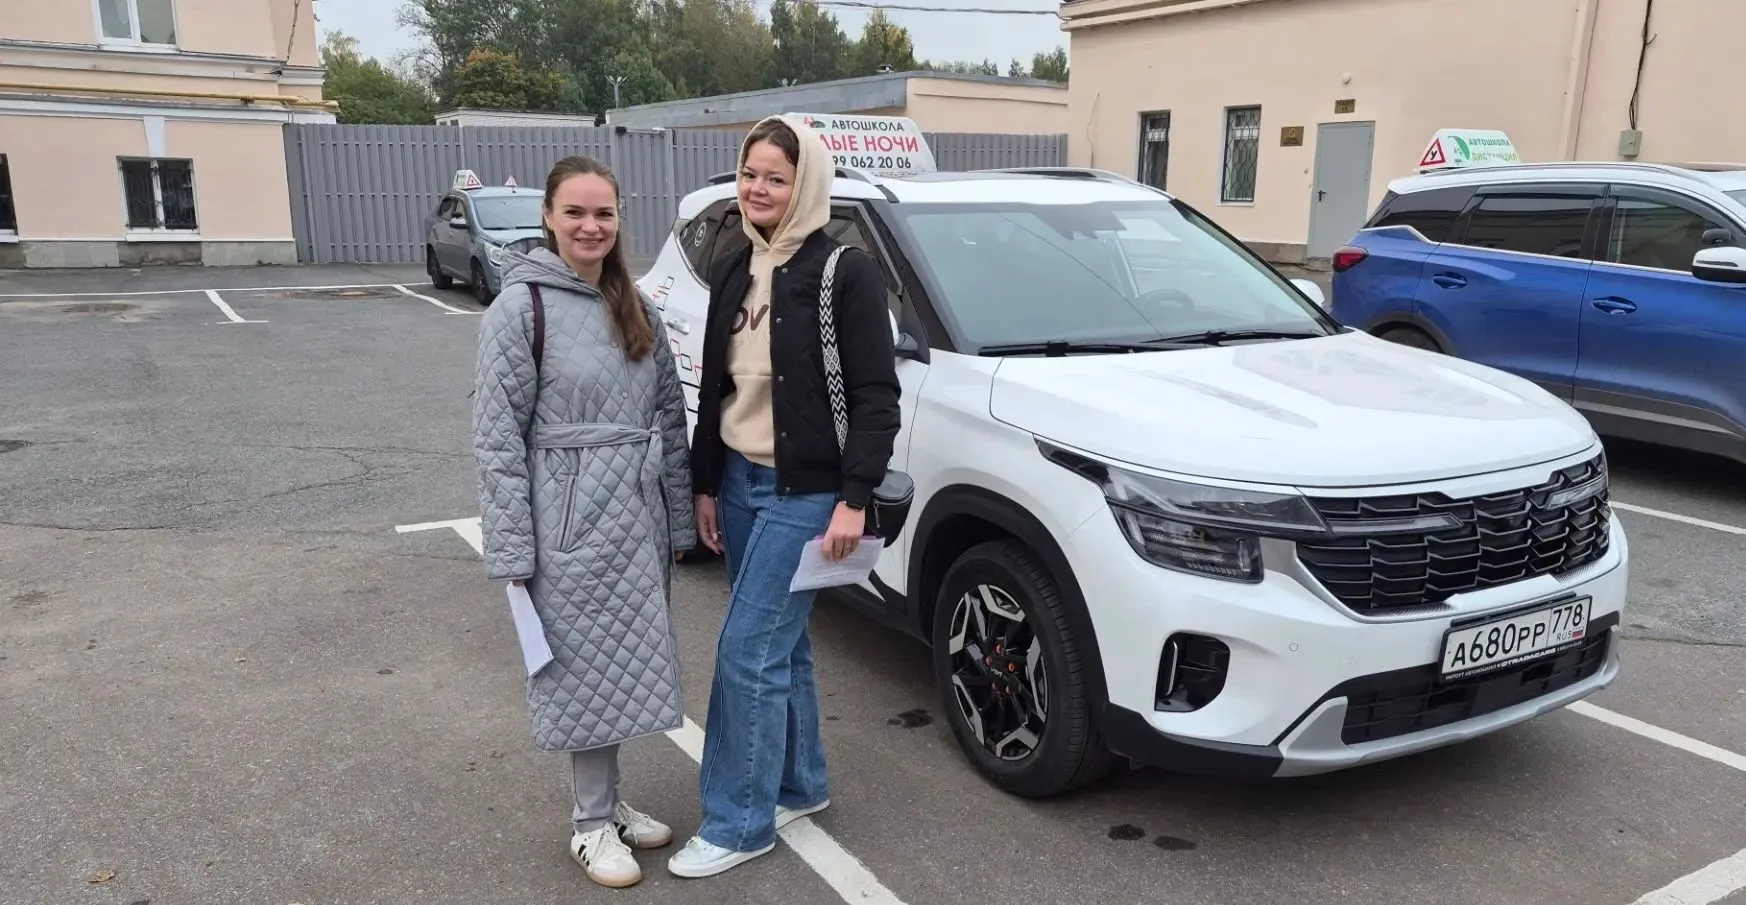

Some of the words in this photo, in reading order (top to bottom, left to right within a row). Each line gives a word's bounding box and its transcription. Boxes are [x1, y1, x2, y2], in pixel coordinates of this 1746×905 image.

[831, 119, 904, 131] АВТОШКОЛА
[863, 135, 918, 152] НОЧИ
[1469, 138, 1511, 146] АВТОШКОЛА
[850, 155, 875, 168] 062
[878, 156, 893, 168] 20
[896, 157, 911, 169] 06
[1552, 603, 1584, 634] 778
[1556, 630, 1572, 641] RUS
